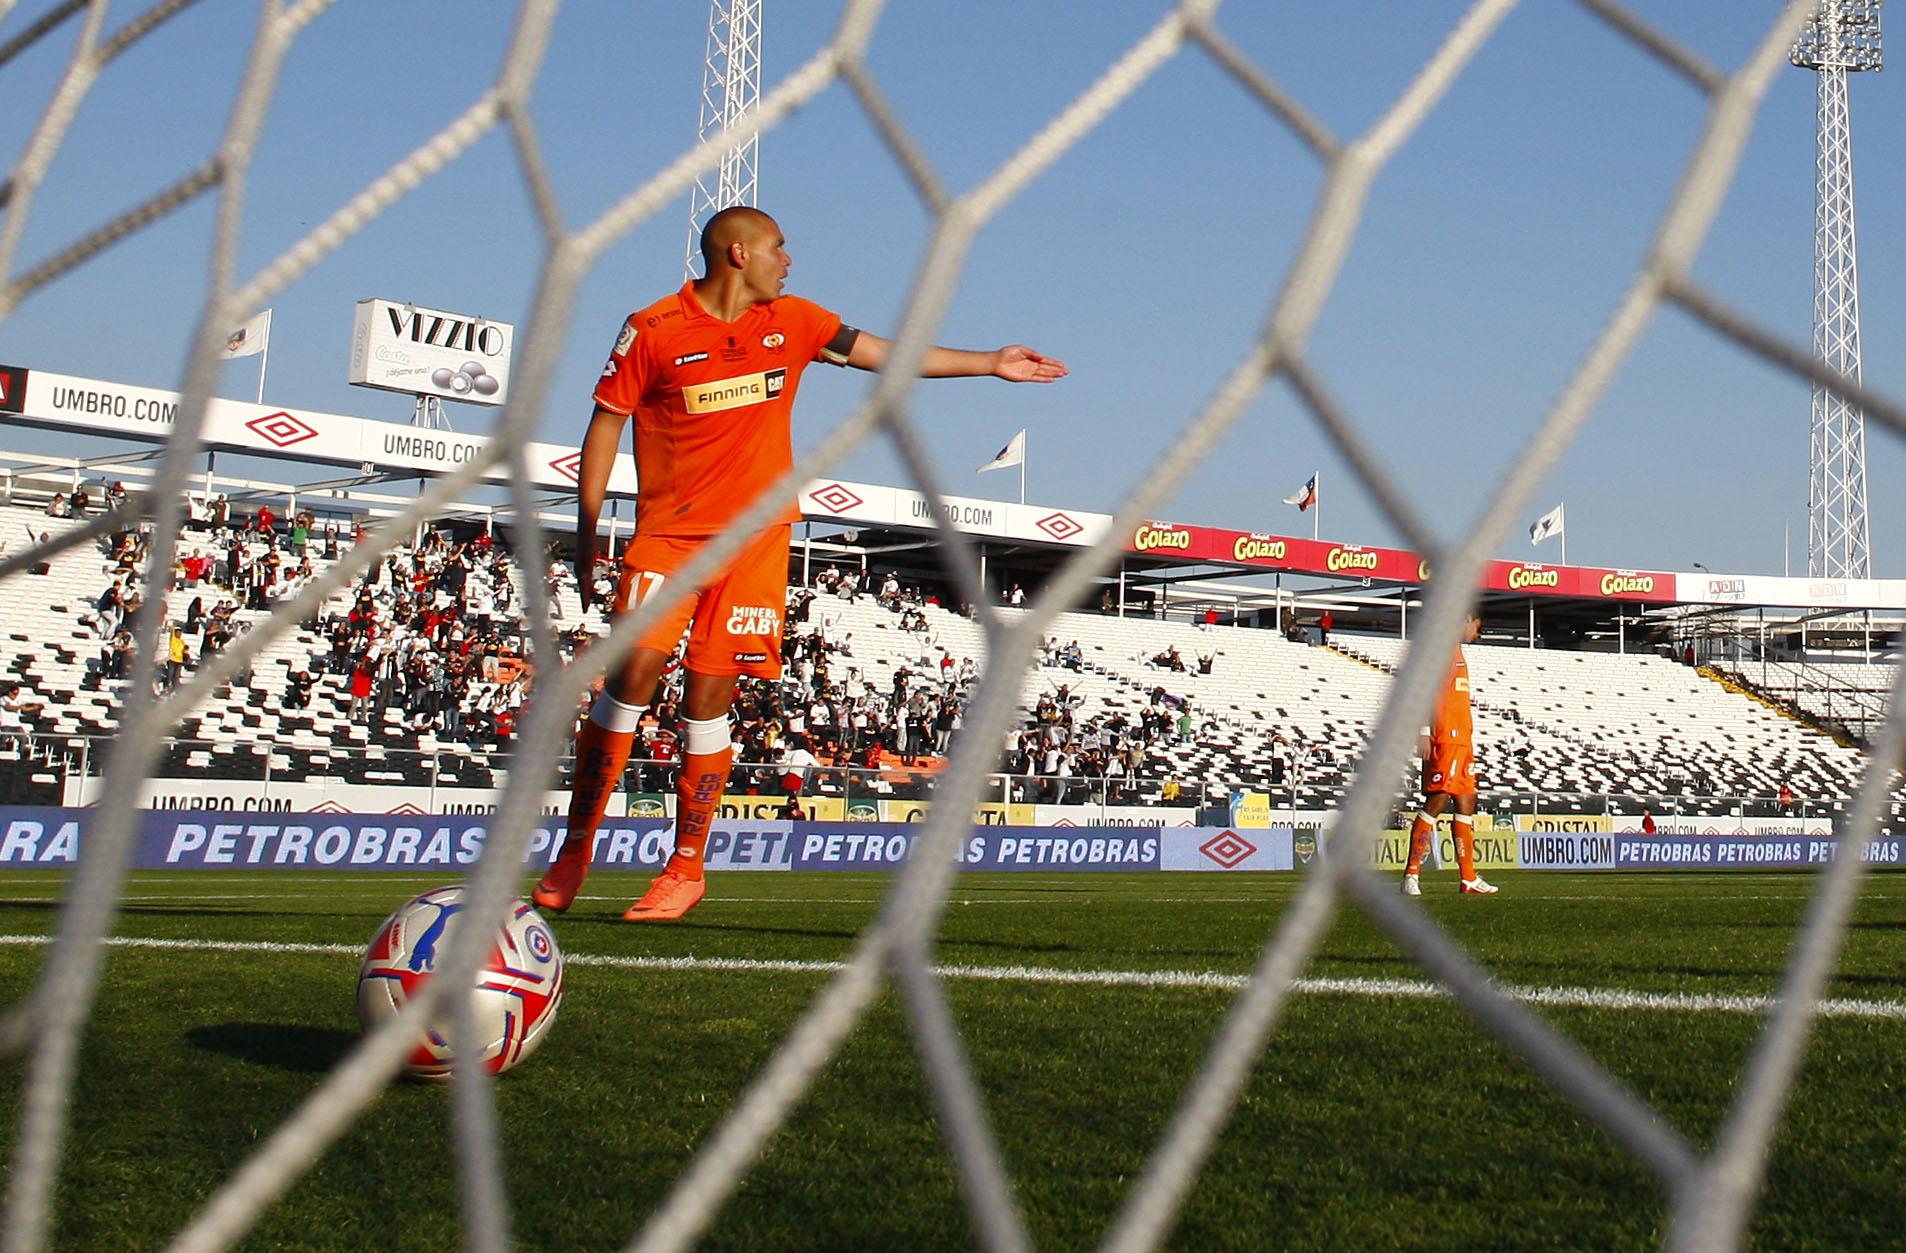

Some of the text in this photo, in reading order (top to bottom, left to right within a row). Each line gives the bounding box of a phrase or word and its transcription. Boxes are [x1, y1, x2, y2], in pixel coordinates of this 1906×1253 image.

[387, 307, 504, 356] VIZZIO
[699, 383, 760, 404] FINNING
[767, 375, 785, 392] CAT
[52, 386, 178, 424] UMBRO.COM
[384, 433, 483, 463] UMBRO.CO
[912, 500, 992, 525] UMRO.COM
[1134, 526, 1190, 550] Golazo
[1234, 536, 1286, 561] Golazo
[1327, 548, 1378, 571] Golazo
[1508, 567, 1559, 589] Golazo
[1601, 574, 1654, 596] Golazo
[732, 605, 777, 618] MINERA
[726, 616, 780, 637] GABY
[166, 823, 488, 864] PETROBRAS
[997, 838, 1157, 864] PETROBRAS
[1522, 837, 1612, 864] UMBRO.COM
[1619, 842, 1710, 862] PETROBRAS
[1717, 843, 1801, 862] PETROBRAS
[1808, 841, 1899, 862] PETBRAS
